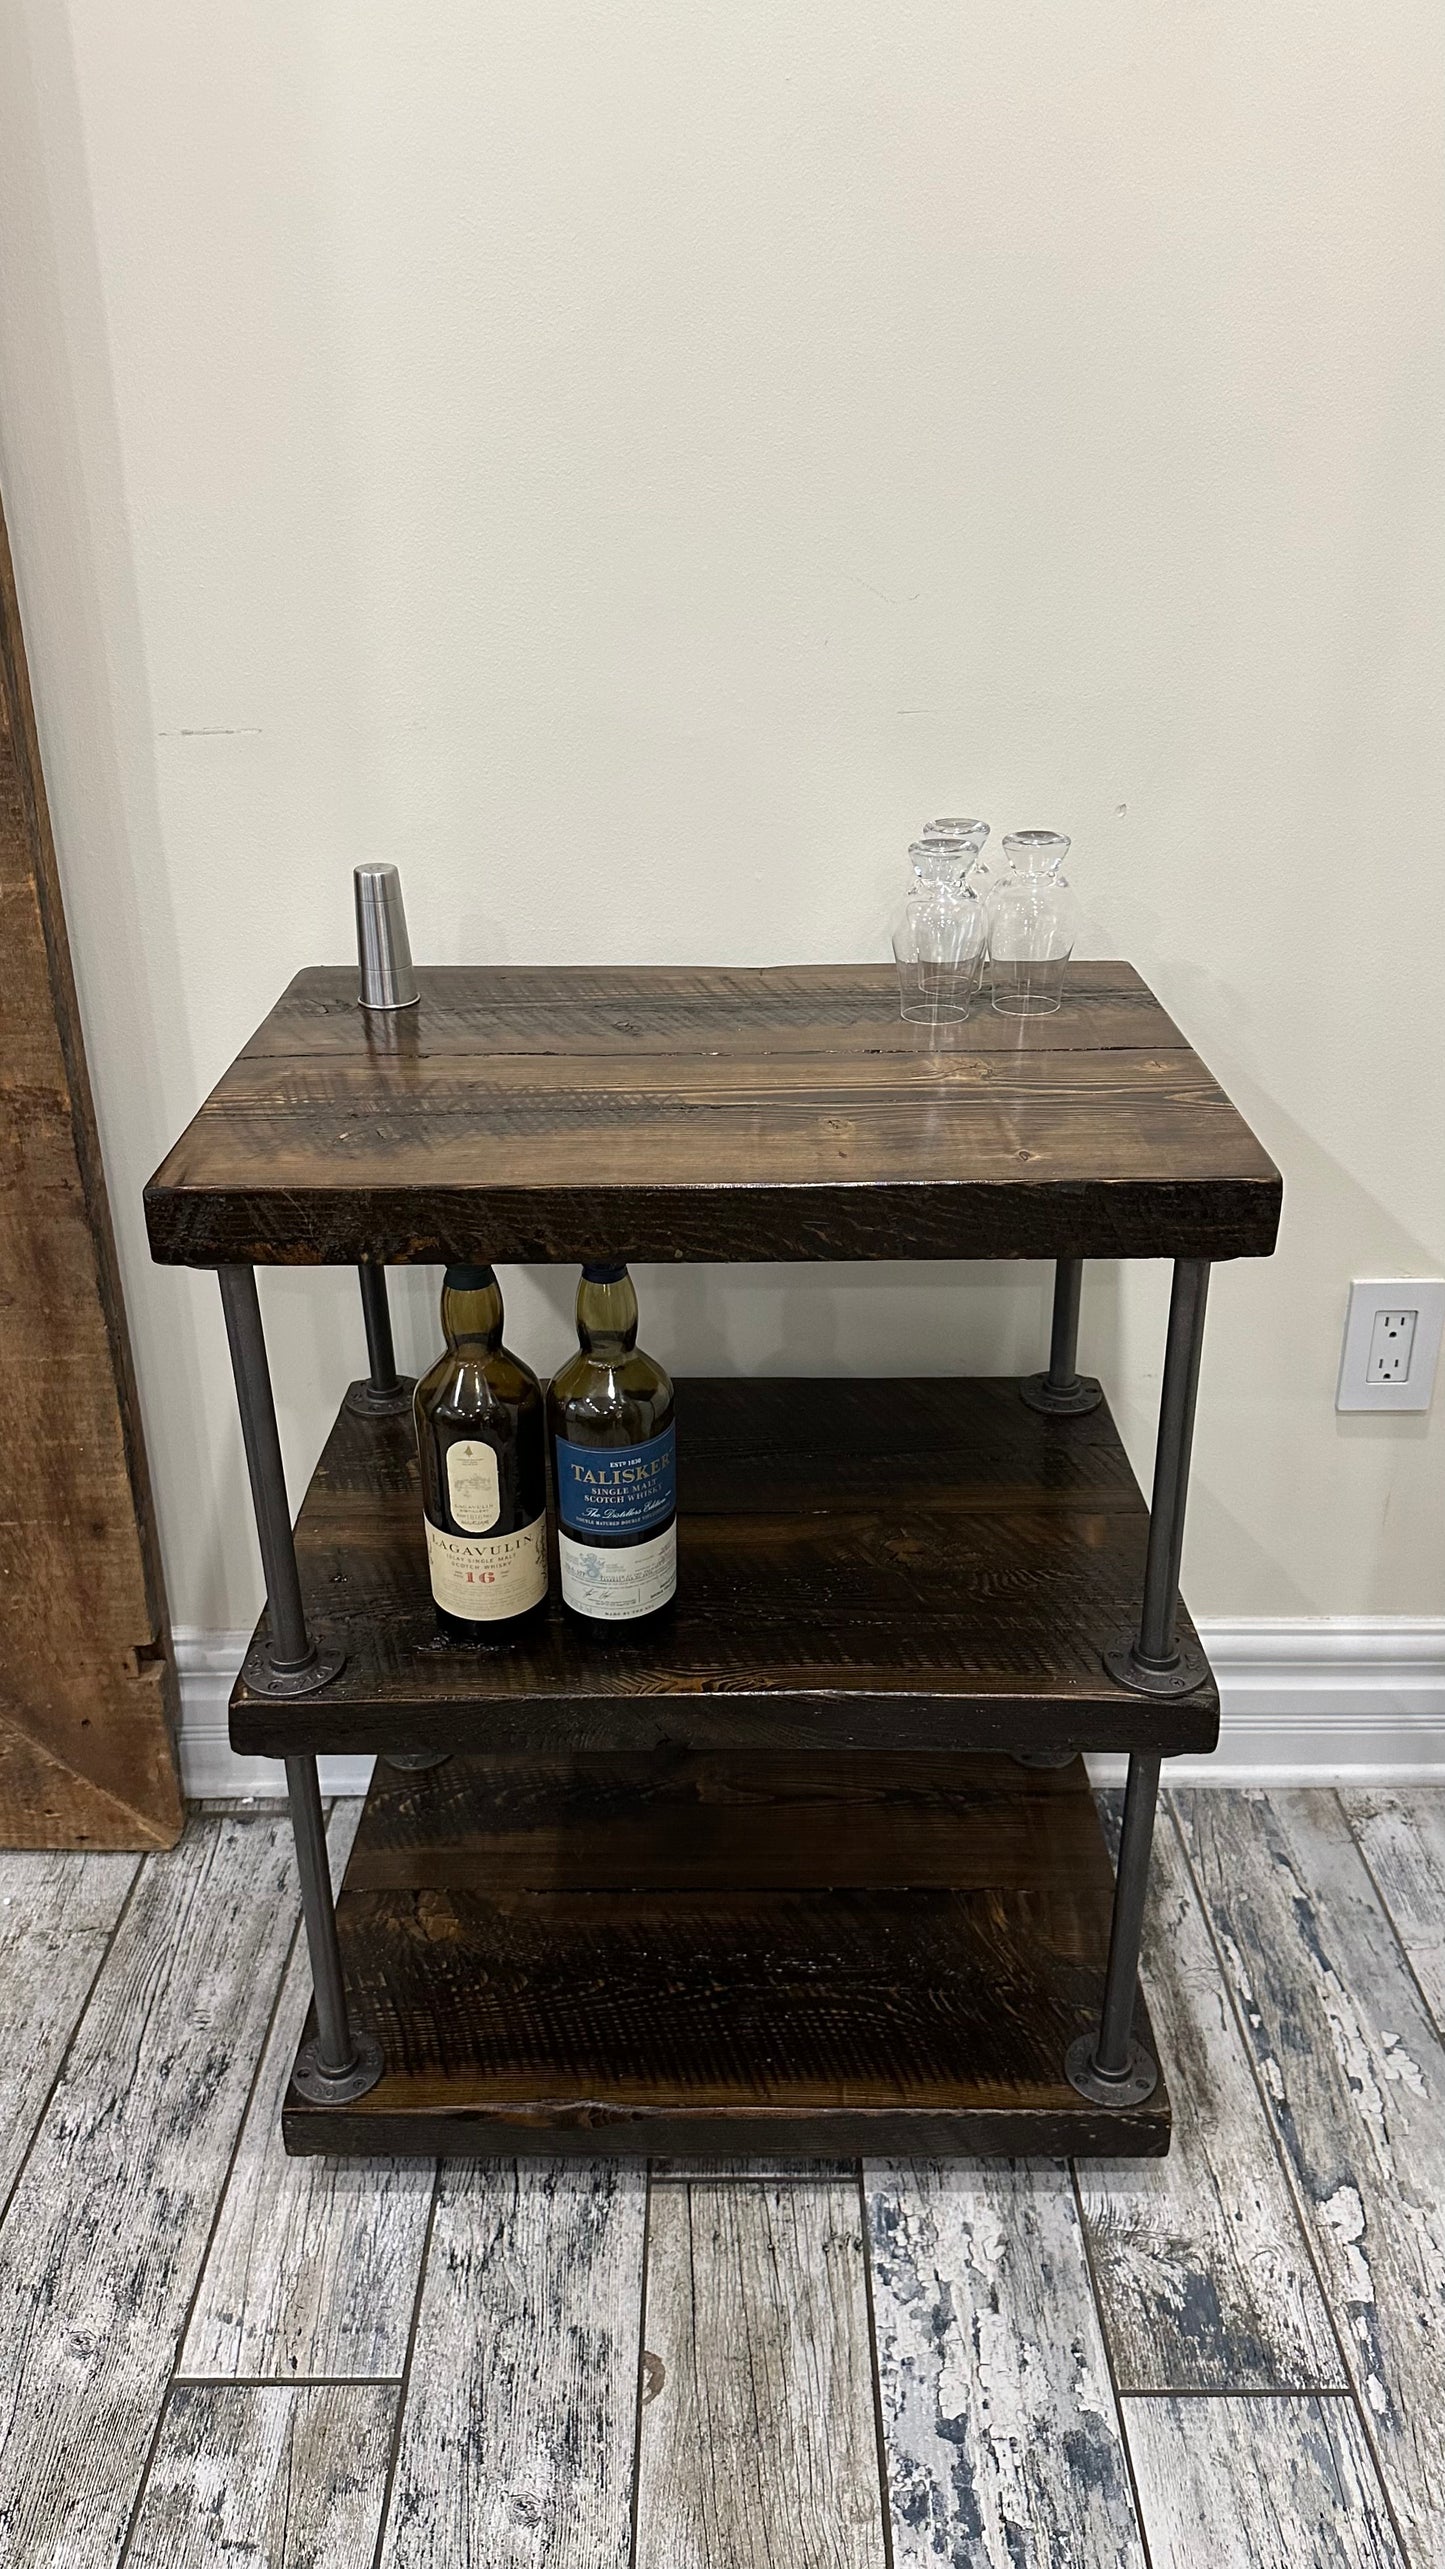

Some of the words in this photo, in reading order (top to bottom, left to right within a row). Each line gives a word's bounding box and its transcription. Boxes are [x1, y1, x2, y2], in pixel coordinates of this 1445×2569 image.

[571, 1453, 670, 1485] TALISKER
[584, 1494, 625, 1504] SCOTCH
[627, 1483, 662, 1502] WHISKY
[591, 1487, 630, 1496] SINGLE
[632, 1479, 658, 1493] MALT
[581, 1506, 601, 1518] The
[602, 1508, 642, 1519] Distillers
[431, 1533, 534, 1556] LAGAVULIN
[497, 1552, 517, 1562] MALT
[451, 1561, 481, 1570] SCOTCH
[484, 1560, 512, 1570] WHISKY
[465, 1571, 496, 1584] 16
